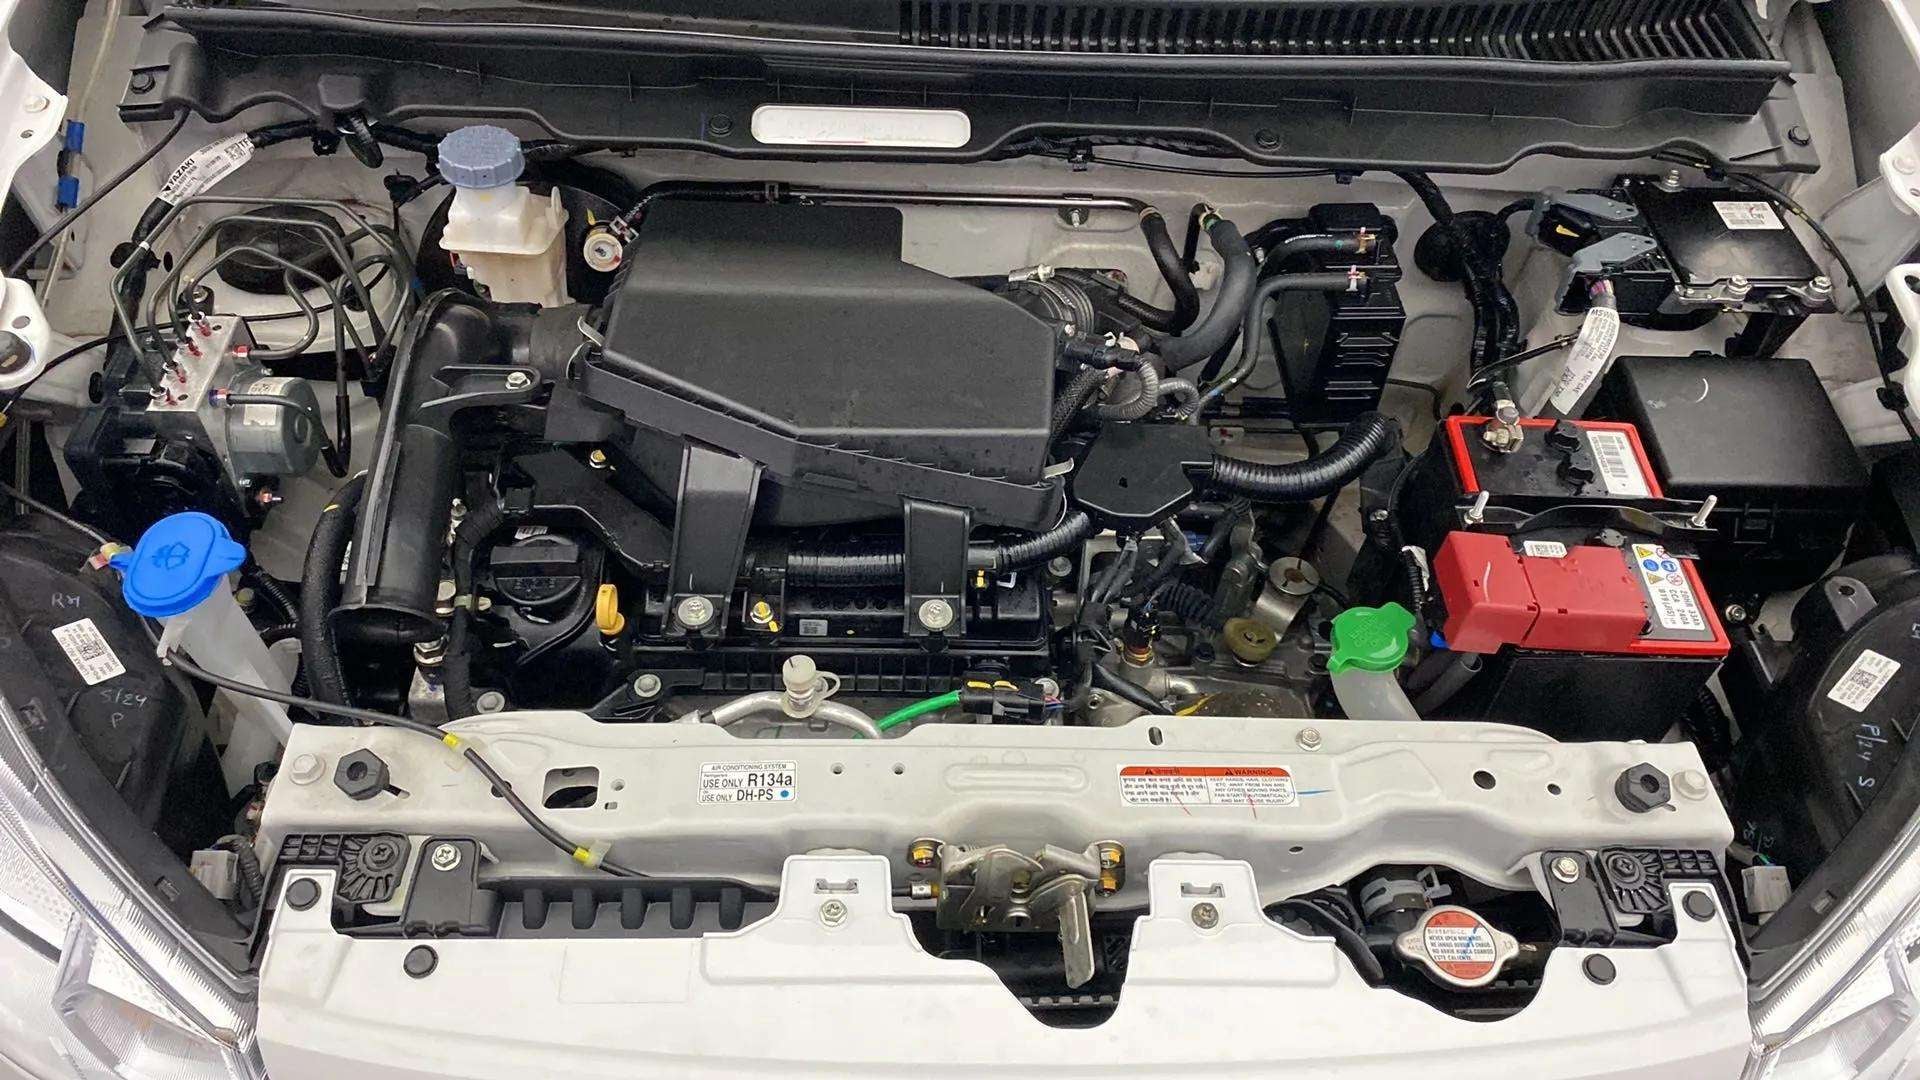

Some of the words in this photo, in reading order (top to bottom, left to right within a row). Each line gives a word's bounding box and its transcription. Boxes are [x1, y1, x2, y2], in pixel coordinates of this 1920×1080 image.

[168, 158, 195, 185] YAZAKI
[1669, 589, 1680, 602] CCA
[703, 779, 719, 788] USE
[722, 778, 744, 788] ONLY
[748, 772, 792, 787] R134a
[1858, 776, 1876, 788] S
[737, 789, 773, 800] DH-PS
